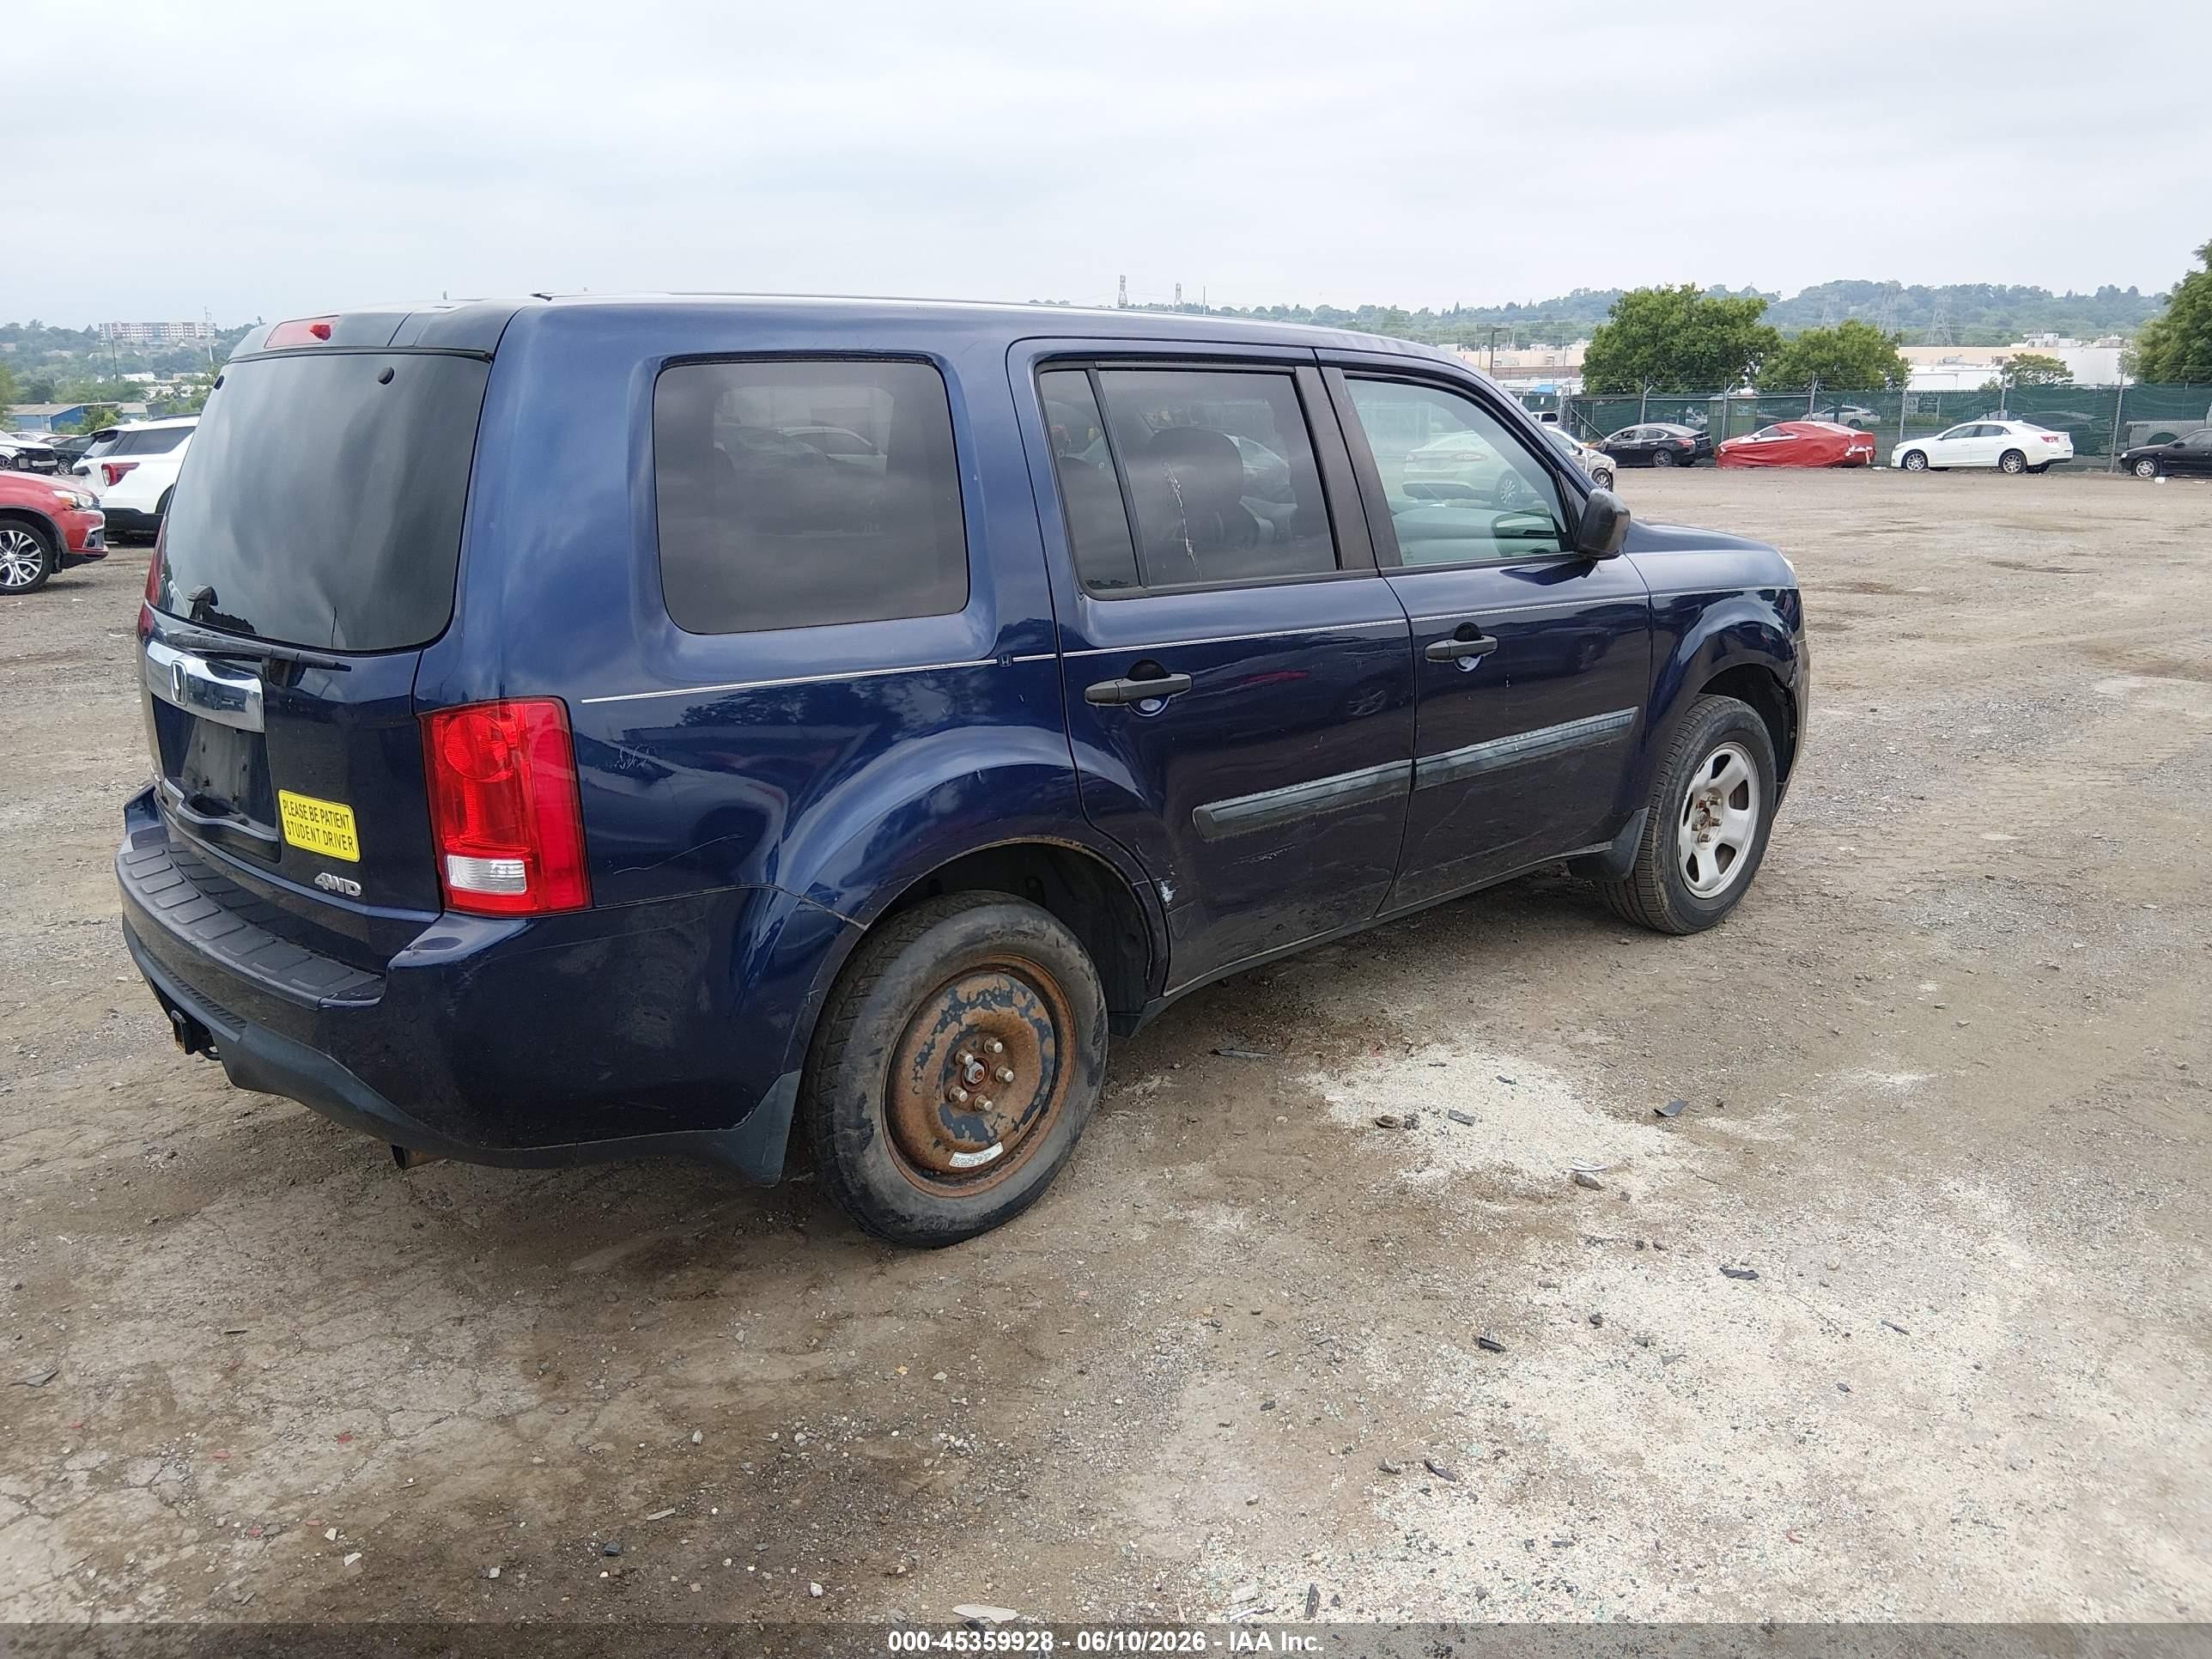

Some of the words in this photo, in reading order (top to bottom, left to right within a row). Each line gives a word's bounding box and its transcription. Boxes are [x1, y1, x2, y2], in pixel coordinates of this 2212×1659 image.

[282, 799, 309, 821] PLEASE
[309, 806, 320, 823] BE
[319, 808, 350, 831] PATIENT
[286, 819, 321, 845] STUDENT
[322, 830, 356, 853] DRIVER
[314, 872, 362, 897] 4WD
